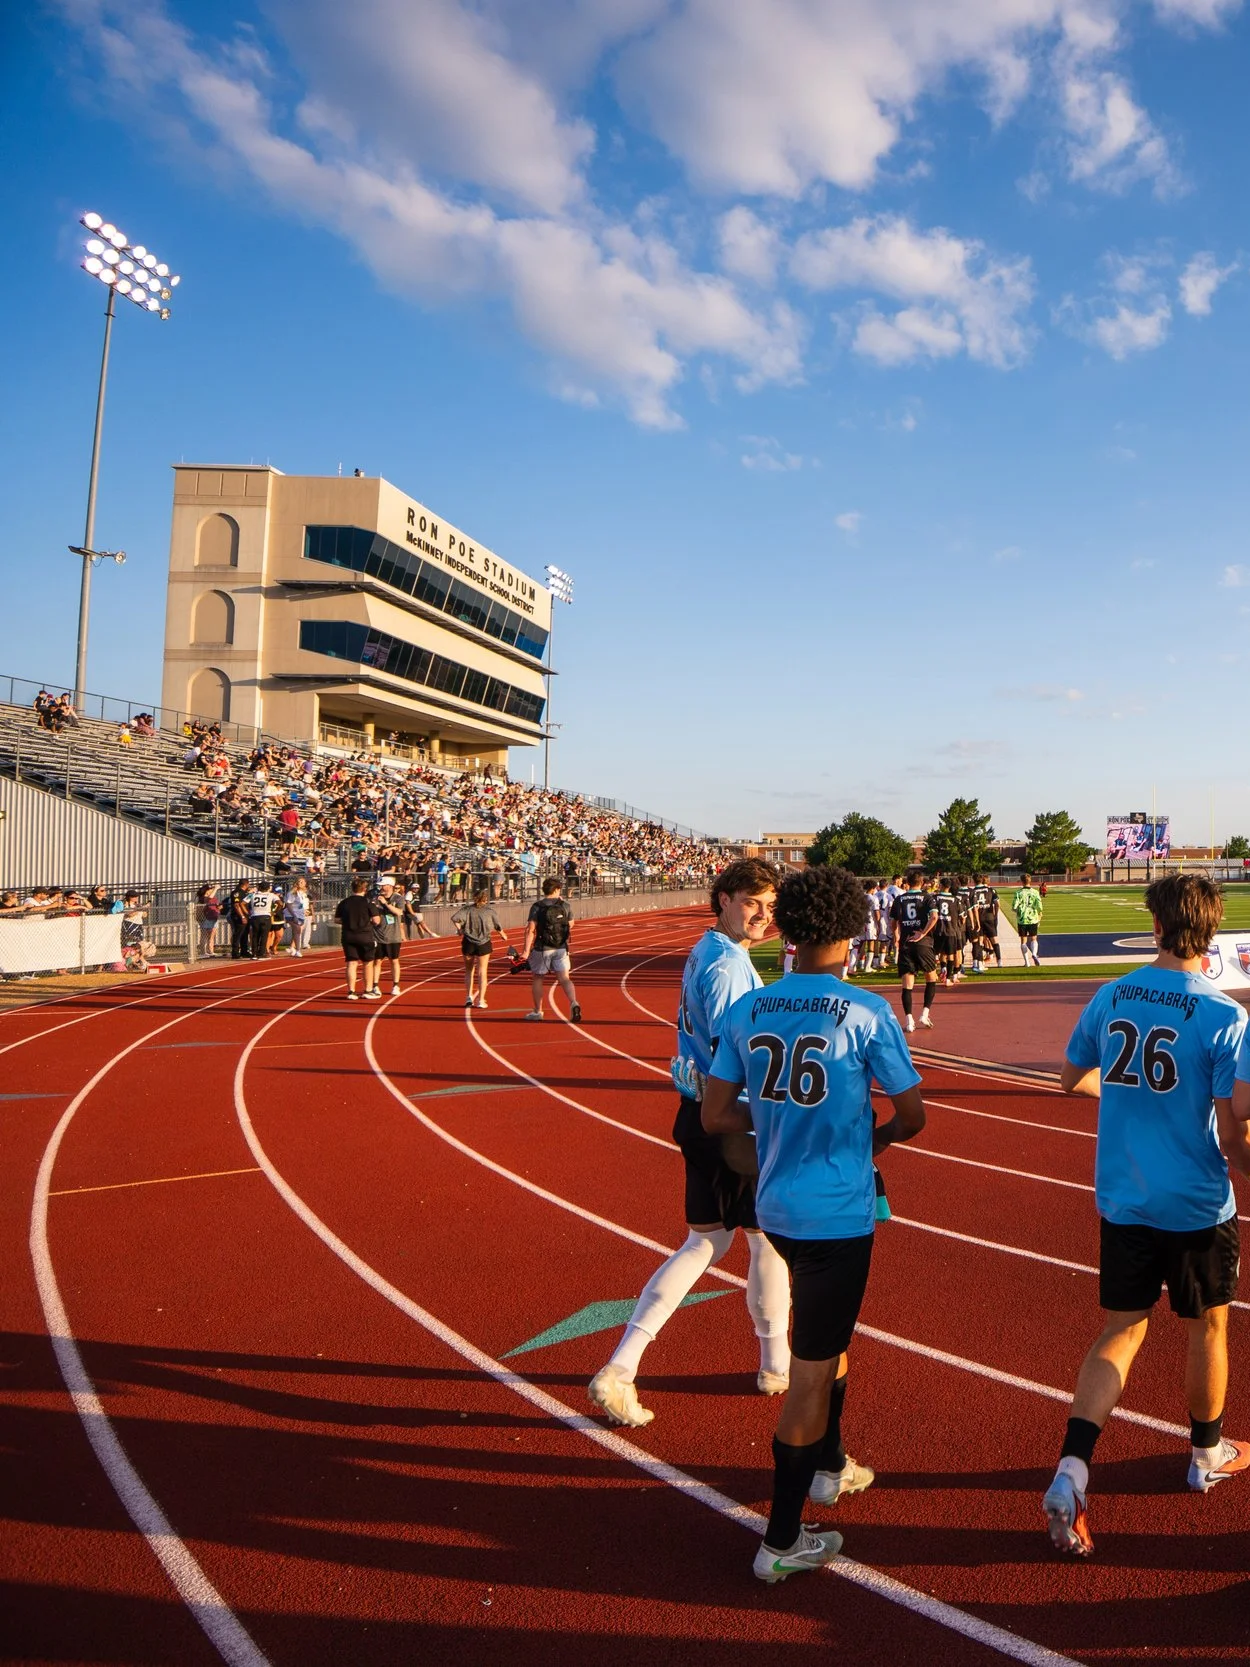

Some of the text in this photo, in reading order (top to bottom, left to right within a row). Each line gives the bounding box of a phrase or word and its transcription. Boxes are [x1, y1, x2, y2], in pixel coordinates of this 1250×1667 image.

[407, 507, 536, 601] RON POE STADIUM
[406, 530, 535, 615] McKINNEY INDEPENDENT SCHOOL DISTRICT
[254, 897, 267, 907] 25
[907, 902, 917, 919] 6
[941, 902, 949, 915] 8
[977, 893, 987, 904] 4
[752, 997, 850, 1029] CHUPACABRAS
[1112, 984, 1198, 1022] CHUPACABRAS
[748, 1032, 829, 1107] 26
[1102, 1019, 1179, 1094] 26
